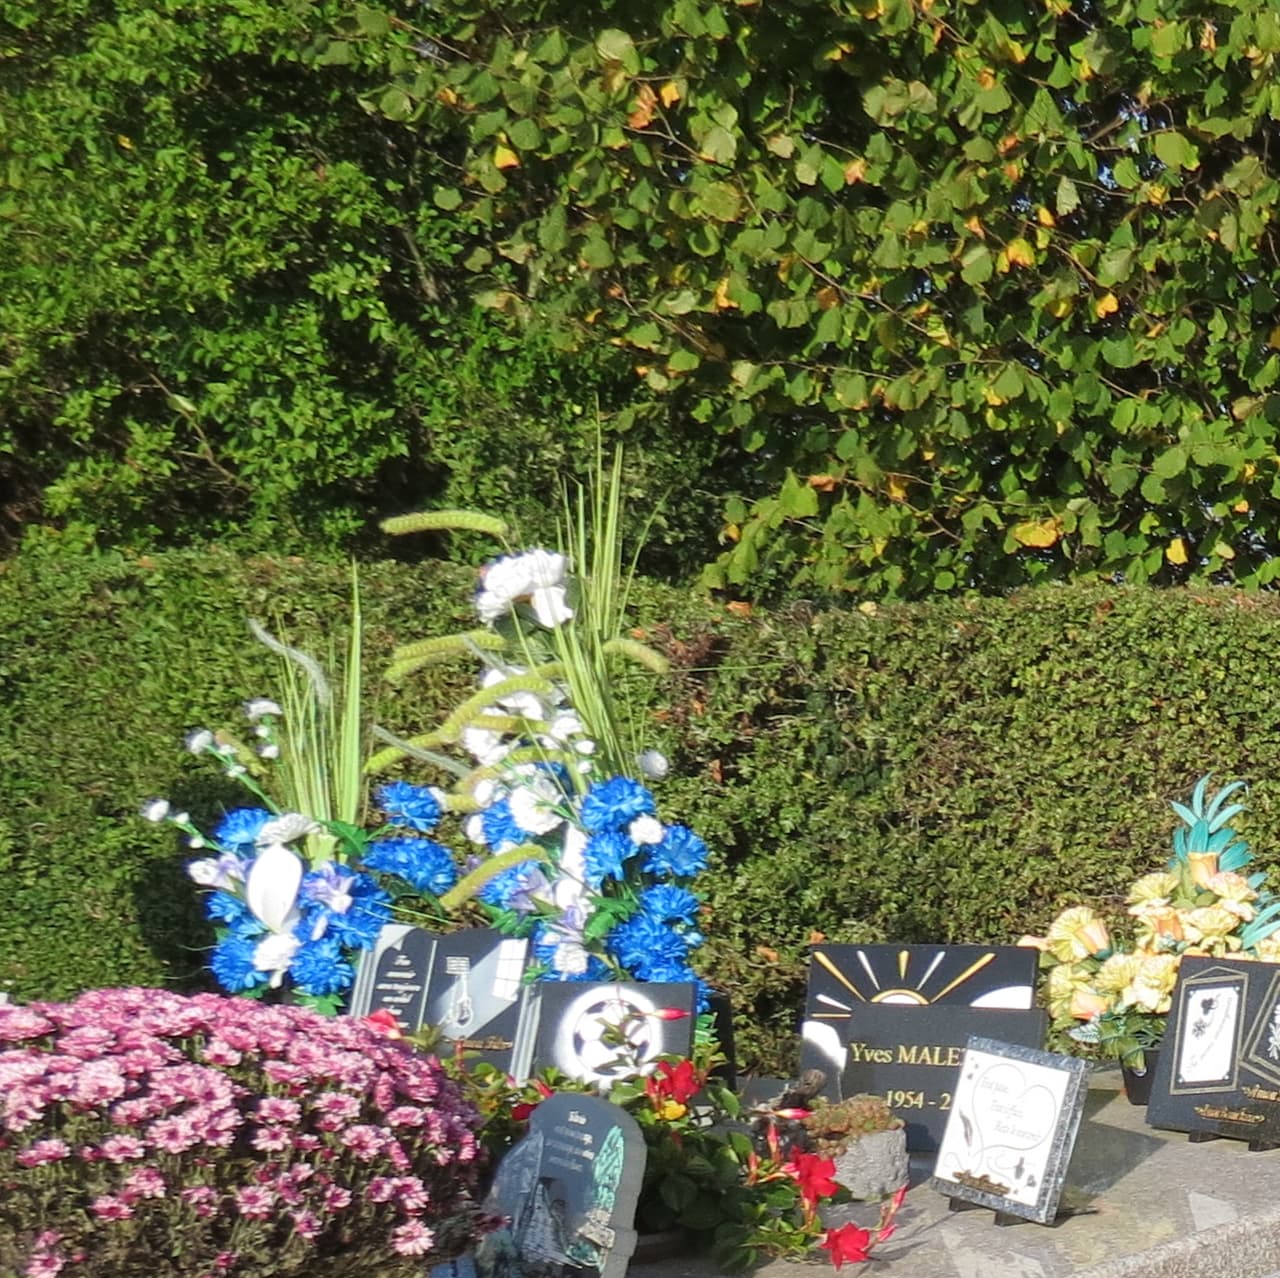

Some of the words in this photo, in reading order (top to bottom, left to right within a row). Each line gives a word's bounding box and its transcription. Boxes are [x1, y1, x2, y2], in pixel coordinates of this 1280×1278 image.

[850, 1042, 893, 1063] Yves
[897, 1044, 968, 1067] MALE
[886, 1089, 924, 1109] 1954
